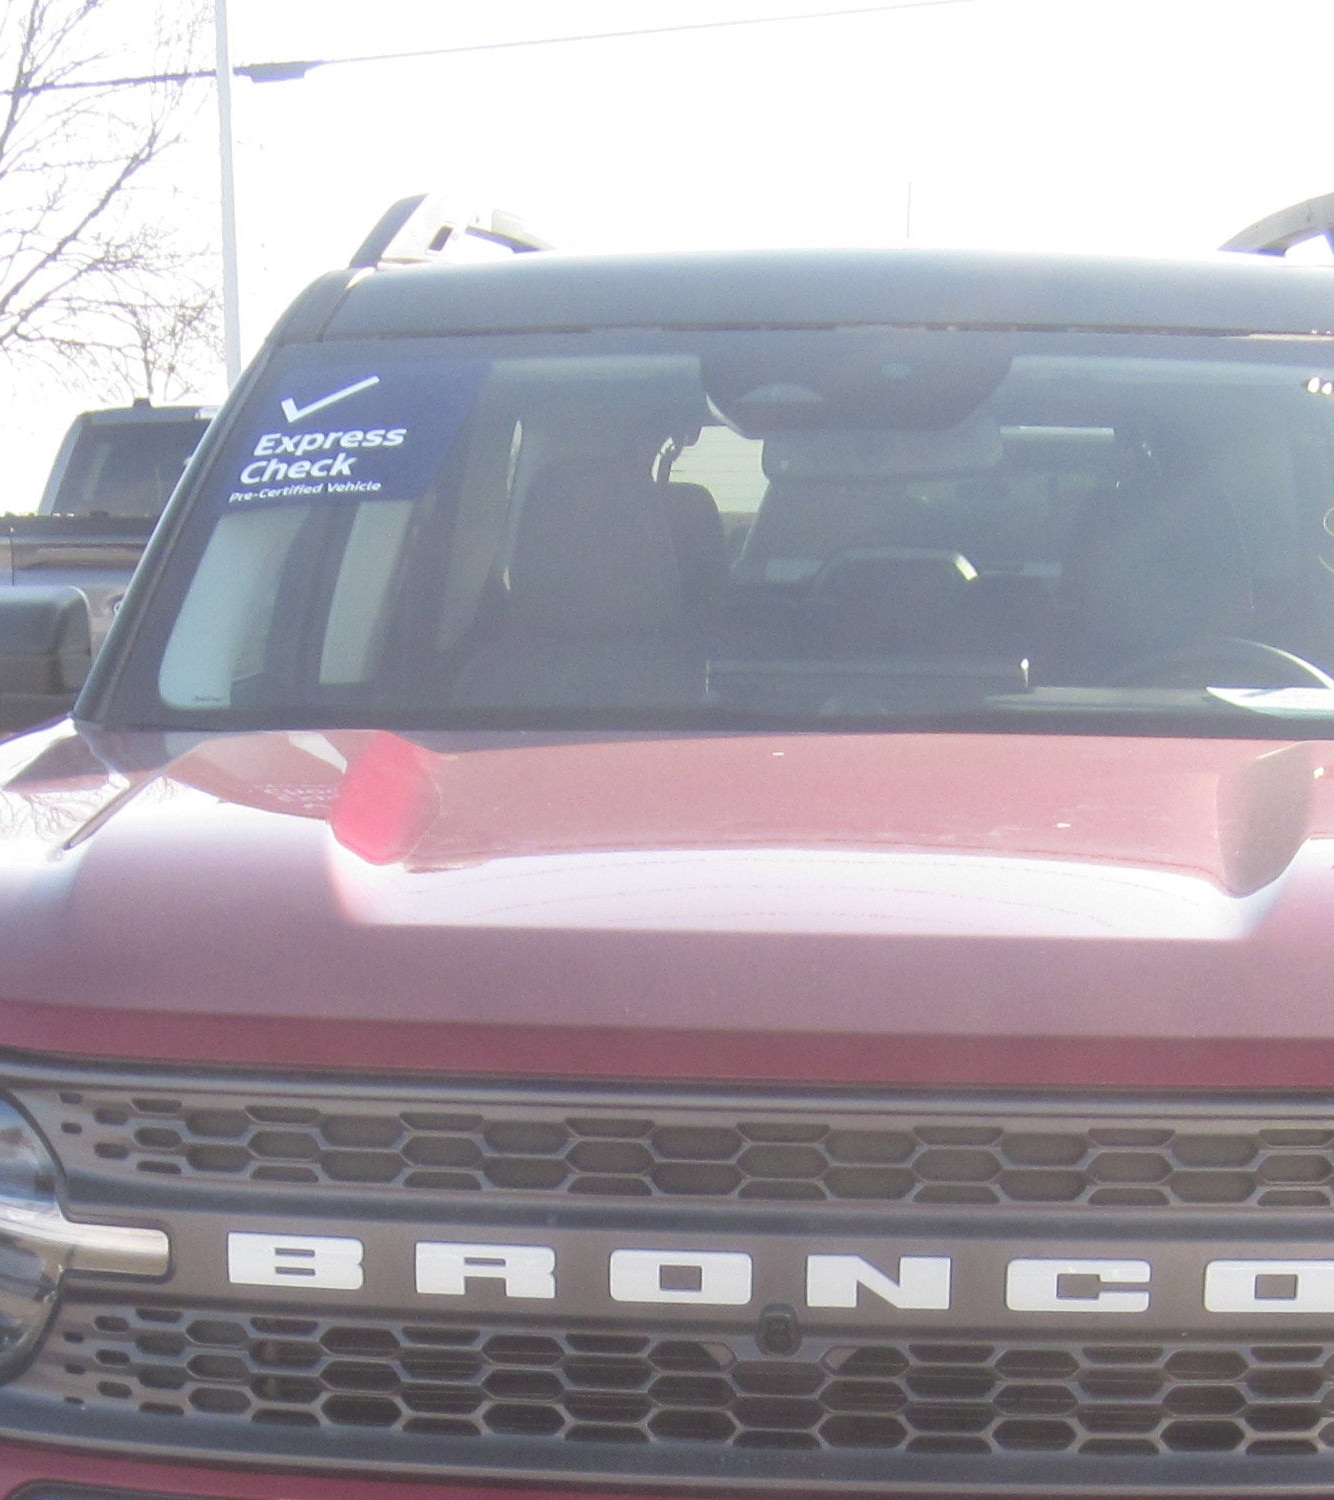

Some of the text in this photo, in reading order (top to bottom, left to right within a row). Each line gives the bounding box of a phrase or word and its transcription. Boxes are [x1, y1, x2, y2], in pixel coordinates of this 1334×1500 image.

[254, 429, 407, 456] Express
[240, 453, 356, 484] Check
[229, 481, 382, 503] Pre-Certified Vehicle
